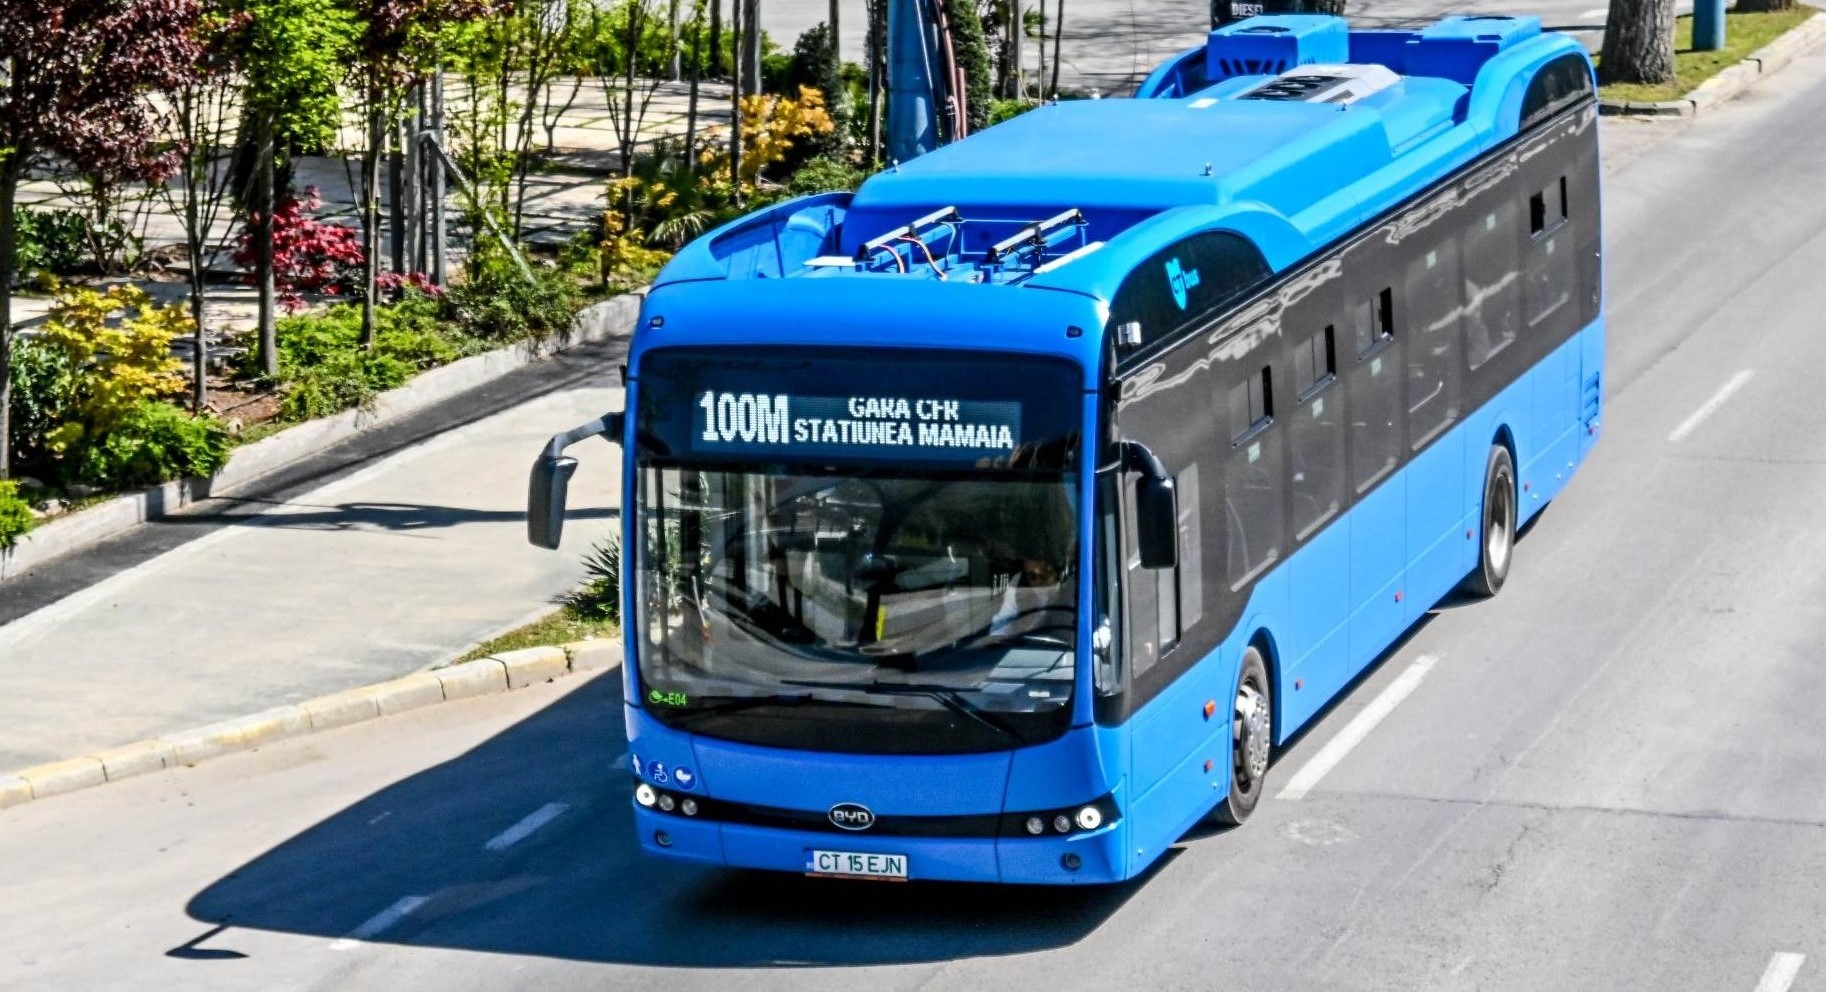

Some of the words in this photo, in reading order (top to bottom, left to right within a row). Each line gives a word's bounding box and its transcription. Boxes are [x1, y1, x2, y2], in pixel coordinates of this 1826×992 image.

[699, 391, 790, 443] 100M
[794, 418, 913, 445] STATIUNEA
[918, 423, 1014, 449] MAMAIA
[833, 810, 869, 823] BYD
[819, 853, 841, 870] CT
[848, 854, 863, 872] 15
[867, 856, 902, 874] EJN
